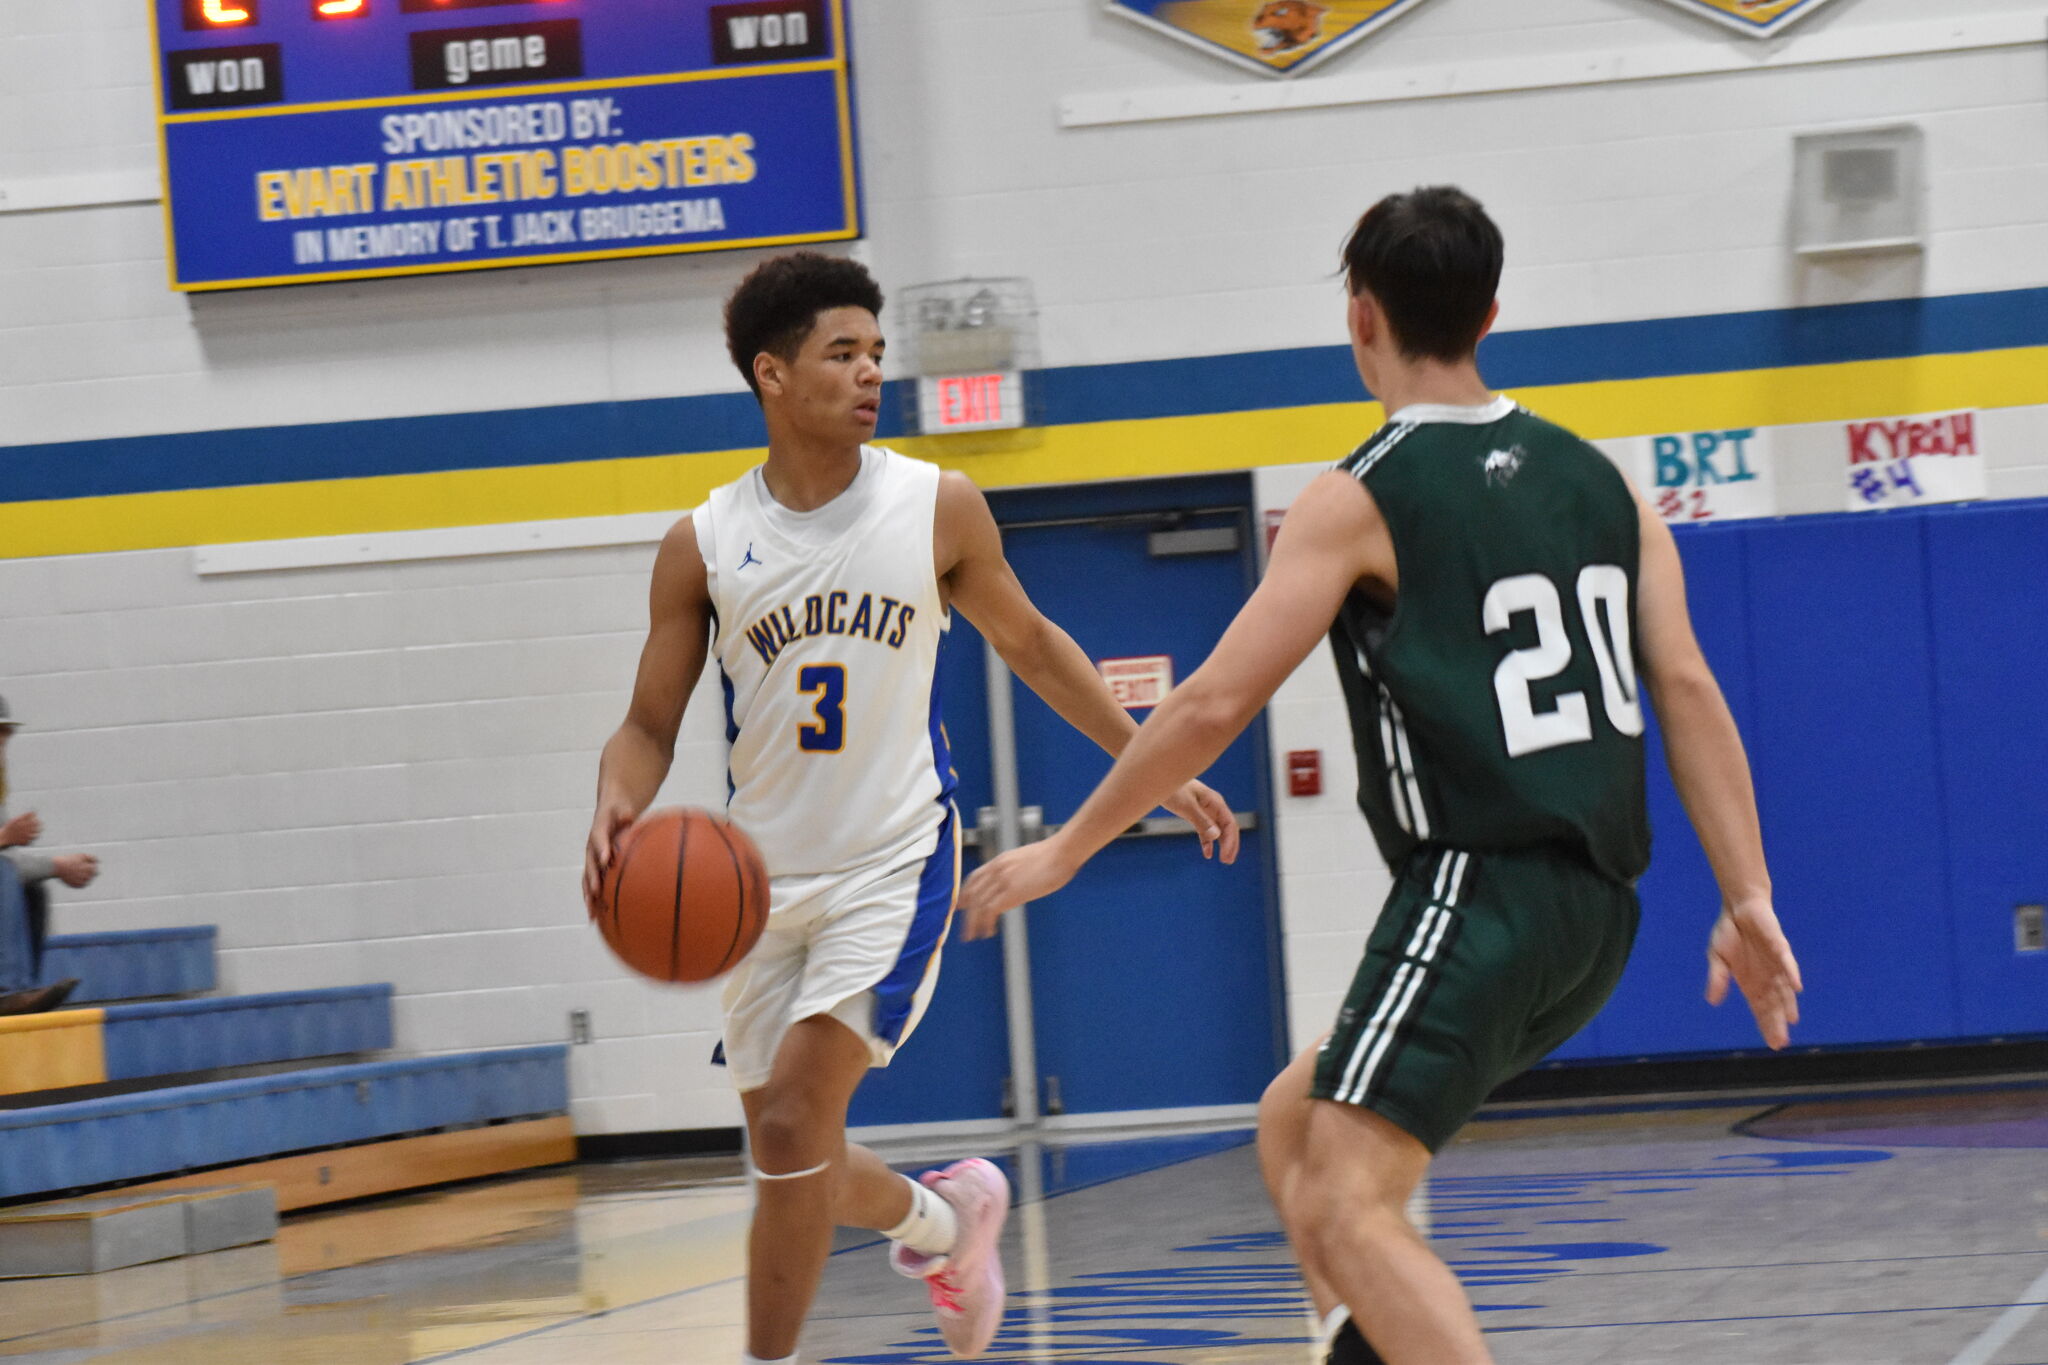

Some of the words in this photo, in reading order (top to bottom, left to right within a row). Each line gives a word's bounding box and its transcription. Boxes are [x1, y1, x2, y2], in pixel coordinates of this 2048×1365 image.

[727, 11, 809, 50] won
[185, 58, 265, 95] won
[444, 35, 547, 84] game
[381, 101, 567, 154] SPONSORED
[570, 97, 624, 140] BY:
[256, 163, 378, 222] EVART
[382, 149, 559, 211] ATHLETIC
[562, 132, 757, 198] BOOSTERS
[293, 231, 325, 265] IN
[328, 221, 442, 262] MEMORY
[445, 217, 480, 252] OF
[484, 215, 508, 249] T.
[510, 210, 578, 247] JACK
[579, 198, 726, 241] BRUGGEMA
[938, 373, 1004, 425] EXIT
[1652, 428, 1760, 488] BRI
[1851, 458, 1925, 504] #4
[1657, 489, 1714, 519] #2
[745, 590, 916, 667] WILDCATS
[1483, 564, 1645, 758] 20
[797, 662, 848, 755] 3
